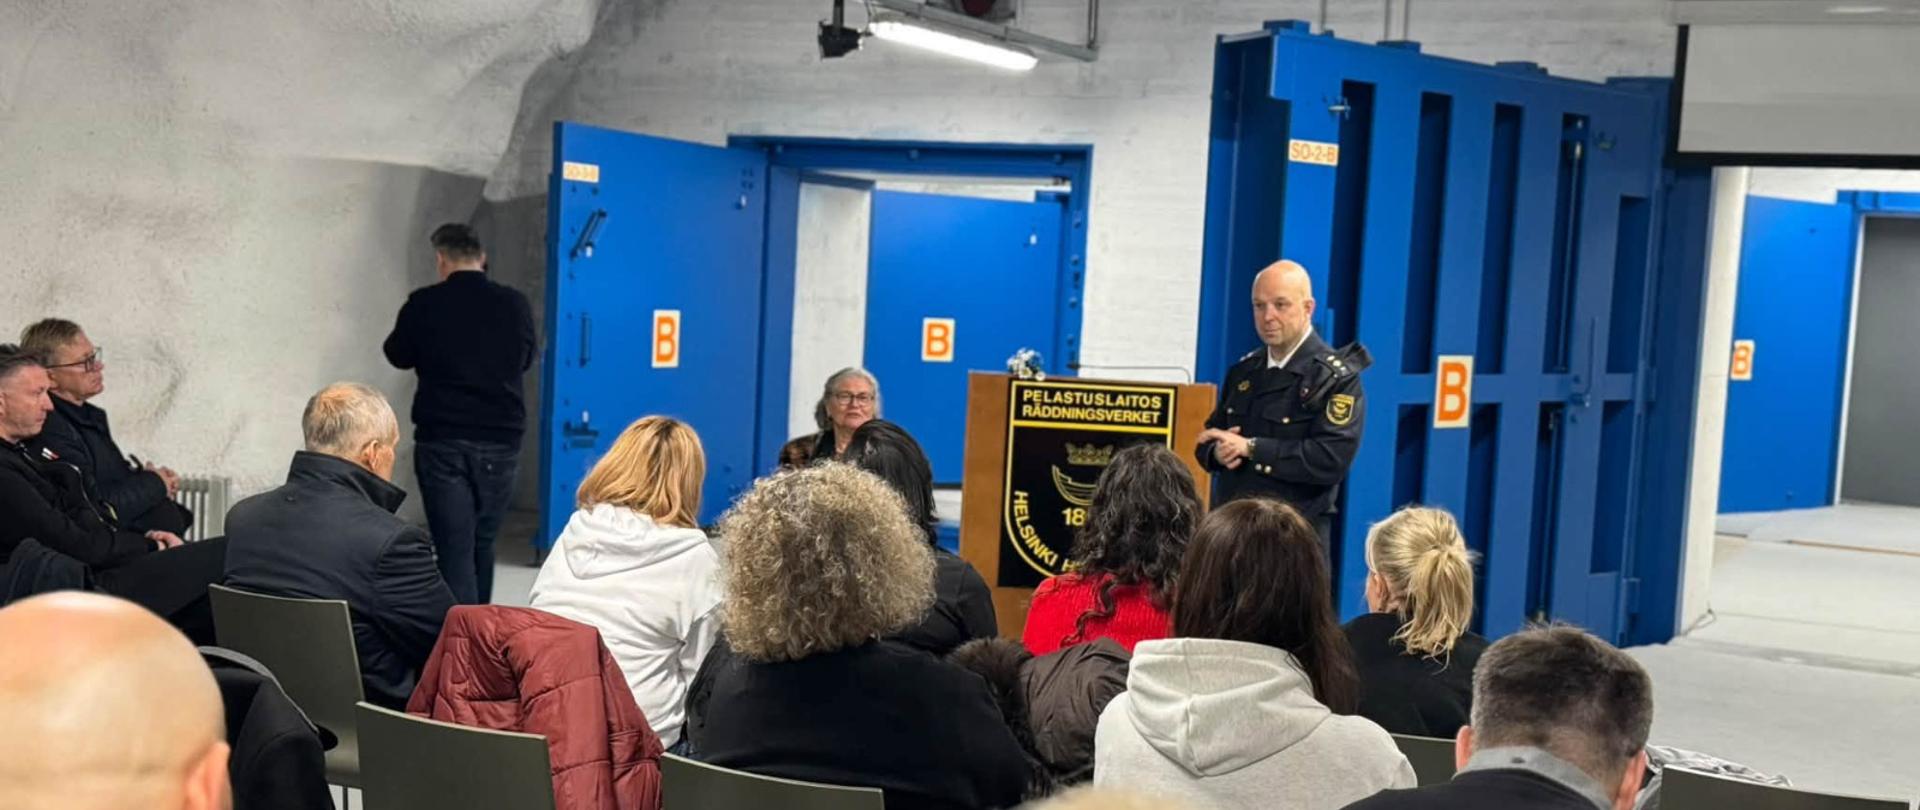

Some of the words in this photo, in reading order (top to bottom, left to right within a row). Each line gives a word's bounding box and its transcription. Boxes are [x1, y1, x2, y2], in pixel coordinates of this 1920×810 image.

[656, 316, 676, 362] B
[927, 323, 949, 356] B
[1733, 345, 1750, 375] B
[1023, 389, 1162, 409] PELASTUSLAITOS
[1438, 362, 1468, 421] B
[1022, 403, 1161, 424] RÄDDNINGSVERKET
[1013, 490, 1058, 566] HELSINKI
[1062, 507, 1087, 526] 18
